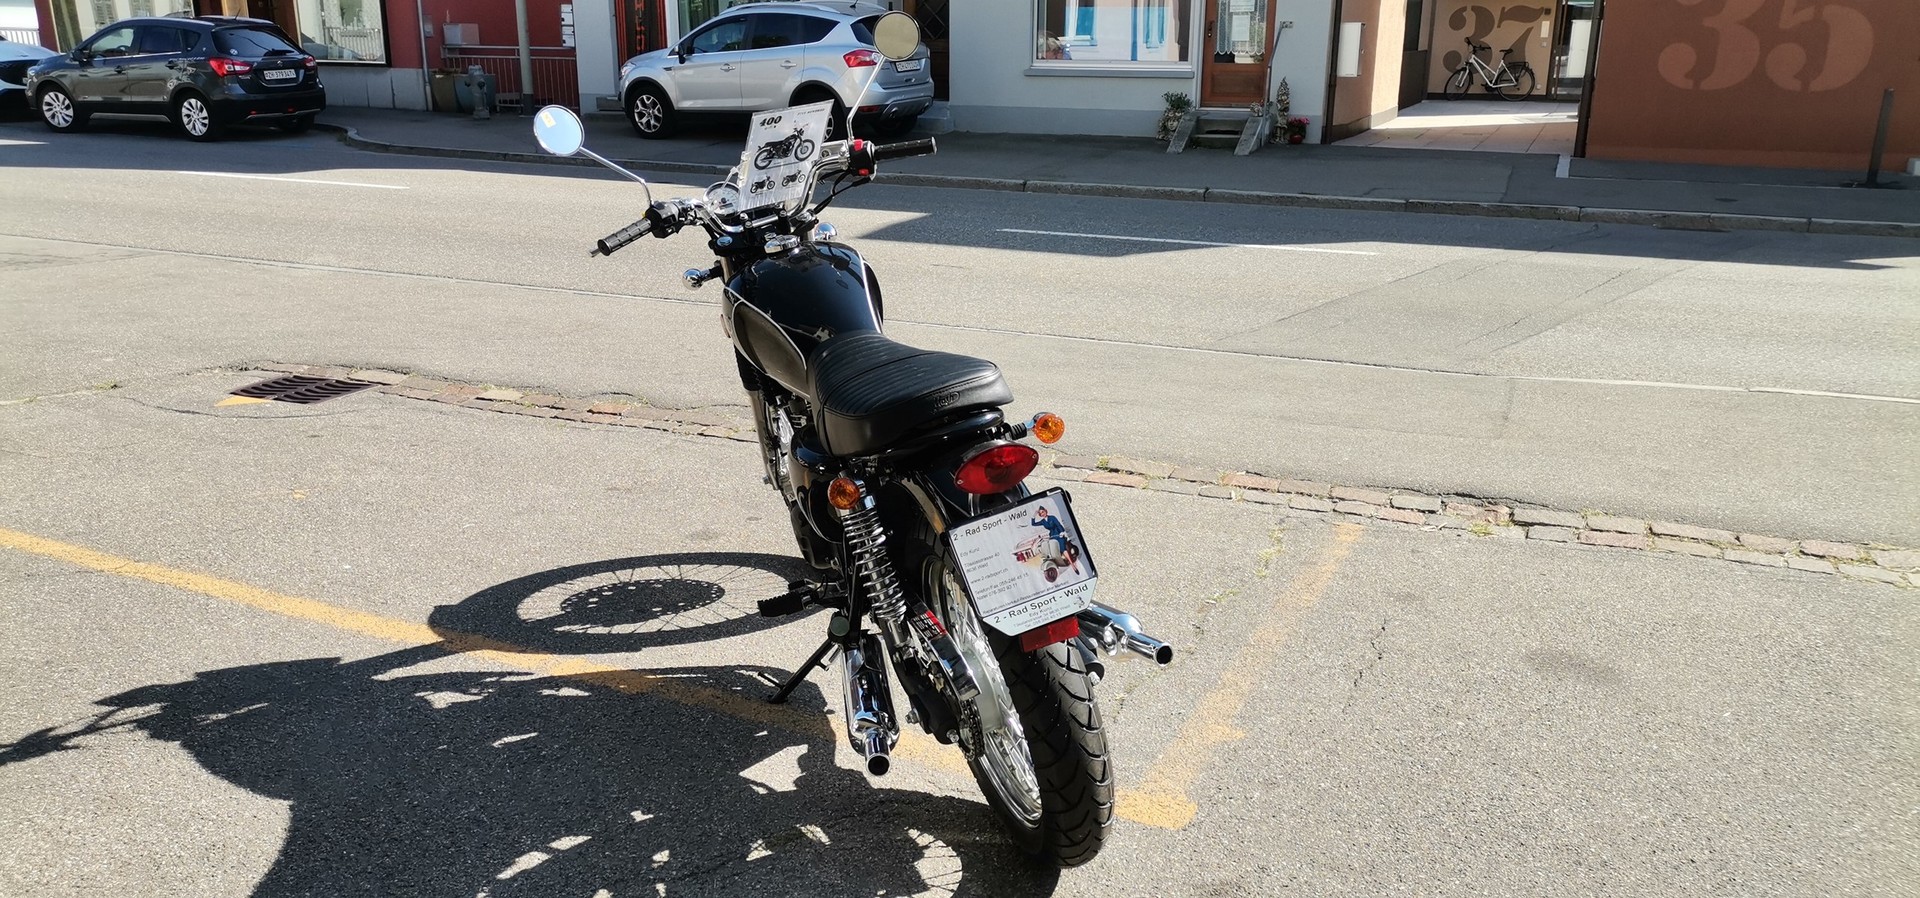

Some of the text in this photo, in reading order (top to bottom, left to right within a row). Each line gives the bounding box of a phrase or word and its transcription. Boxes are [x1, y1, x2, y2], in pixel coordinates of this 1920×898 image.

[1443, 5, 1544, 75] 37
[1658, 0, 1873, 92] 35
[760, 116, 782, 126] 400
[965, 526, 980, 537] Rad
[982, 518, 1002, 532] Sport
[1009, 509, 1027, 521] Wald
[995, 616, 1000, 624] 2
[1009, 606, 1028, 619] Rad
[1031, 595, 1056, 612] Sport
[1065, 583, 1088, 598] Wald
